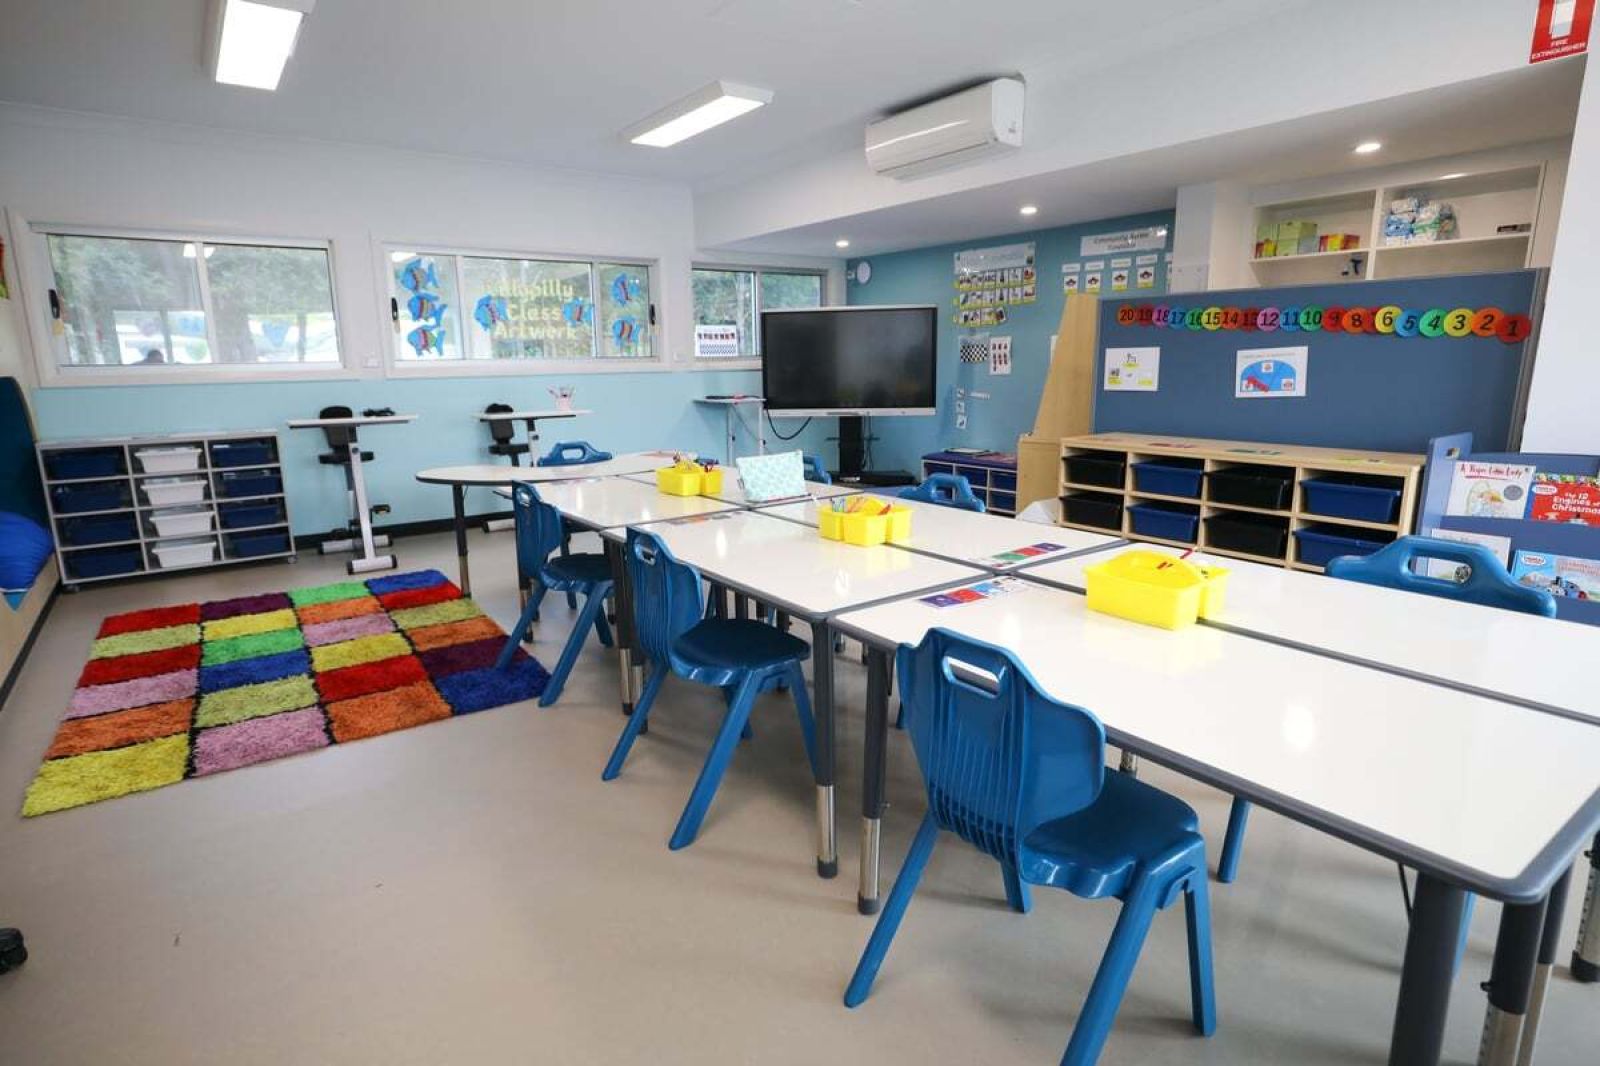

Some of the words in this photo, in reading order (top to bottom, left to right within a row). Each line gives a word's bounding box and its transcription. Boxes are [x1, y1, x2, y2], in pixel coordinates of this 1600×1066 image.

[1531, 42, 1586, 60] EXTINGUISHER
[1551, 39, 1568, 48] FIRE
[507, 303, 561, 321] Class
[1120, 308, 1134, 321] 20
[1171, 311, 1186, 325] 17
[1206, 312, 1221, 325] 15
[1223, 312, 1238, 325] 14
[1260, 311, 1279, 326] 12
[1283, 311, 1300, 326] 11
[1304, 310, 1322, 326] 10
[1351, 313, 1362, 328] 8
[1382, 311, 1393, 327] 6
[1403, 315, 1417, 331] 5
[1427, 315, 1441, 331] 4
[1452, 314, 1466, 331] 3
[1480, 314, 1495, 331] 2
[1507, 319, 1518, 337] 1
[1553, 495, 1591, 507] Engines
